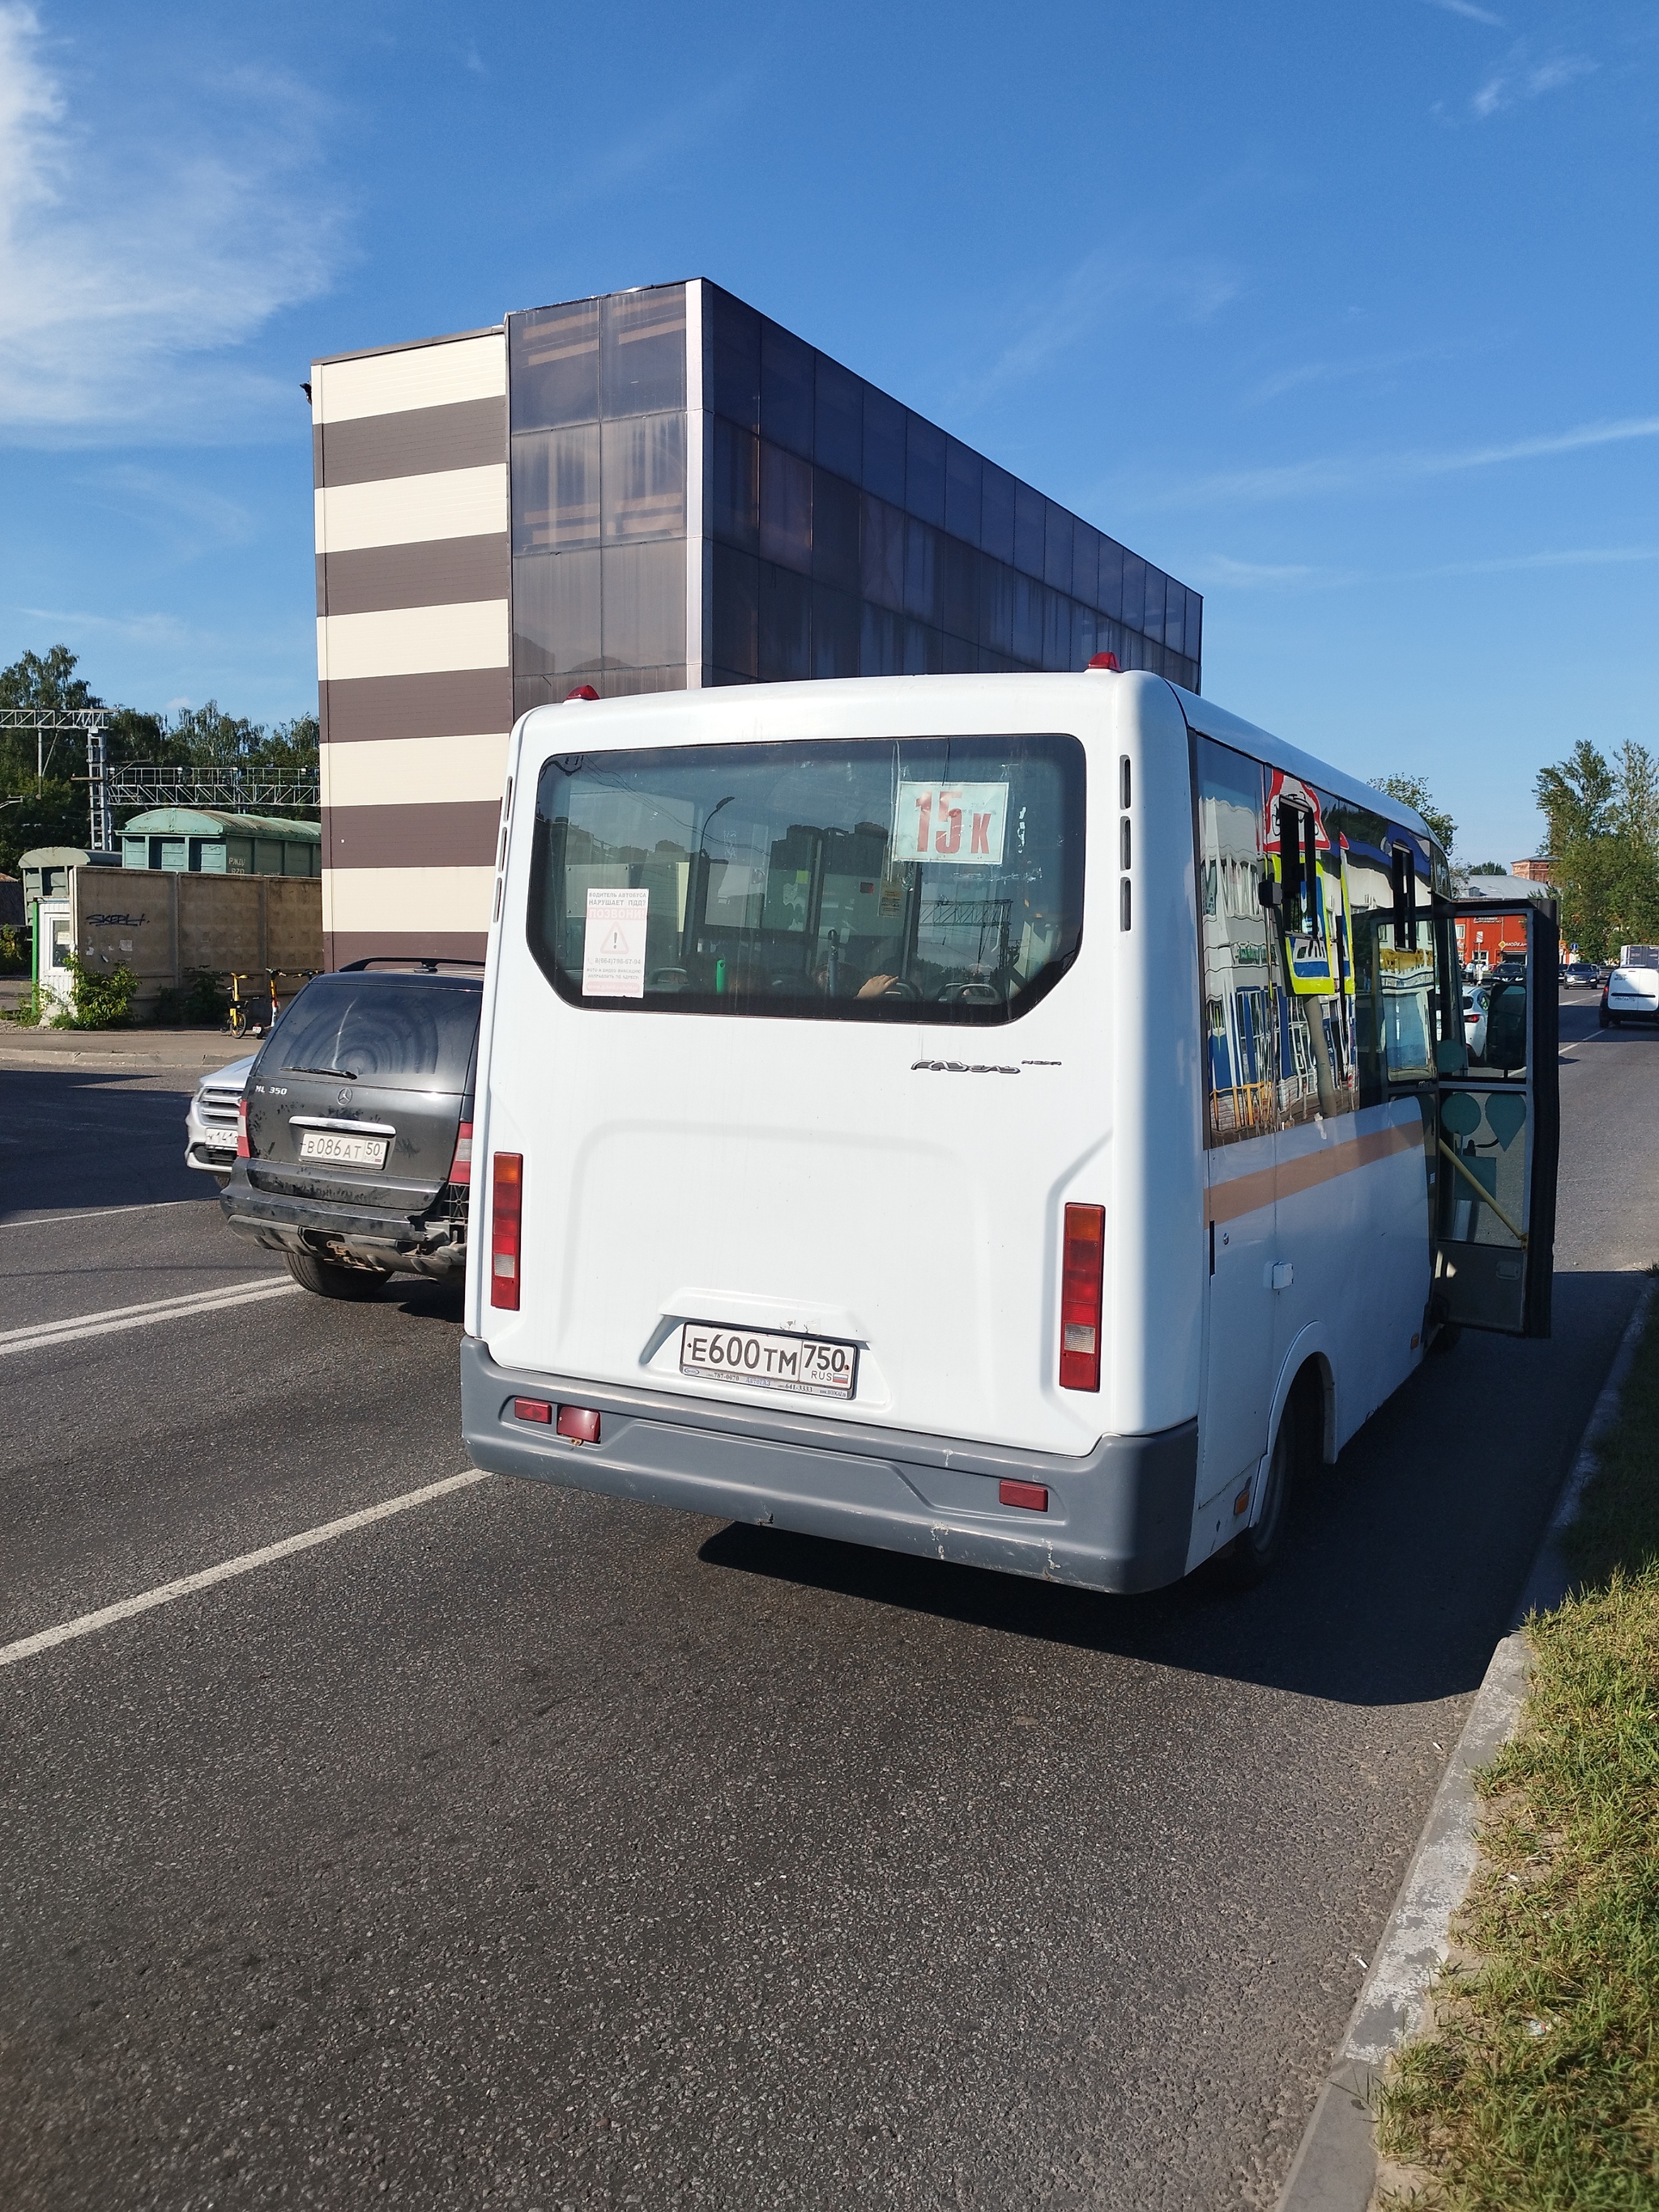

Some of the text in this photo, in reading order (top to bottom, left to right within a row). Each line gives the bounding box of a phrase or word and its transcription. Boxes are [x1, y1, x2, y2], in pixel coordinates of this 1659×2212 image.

[915, 791, 962, 855] 15
[589, 909, 645, 919] ПОЗВОНИ!
[254, 1085, 288, 1095] ML 350
[366, 1142, 380, 1156] 50
[691, 1334, 846, 1376] Е600ТМ 750
[811, 1370, 832, 1382] RUS
